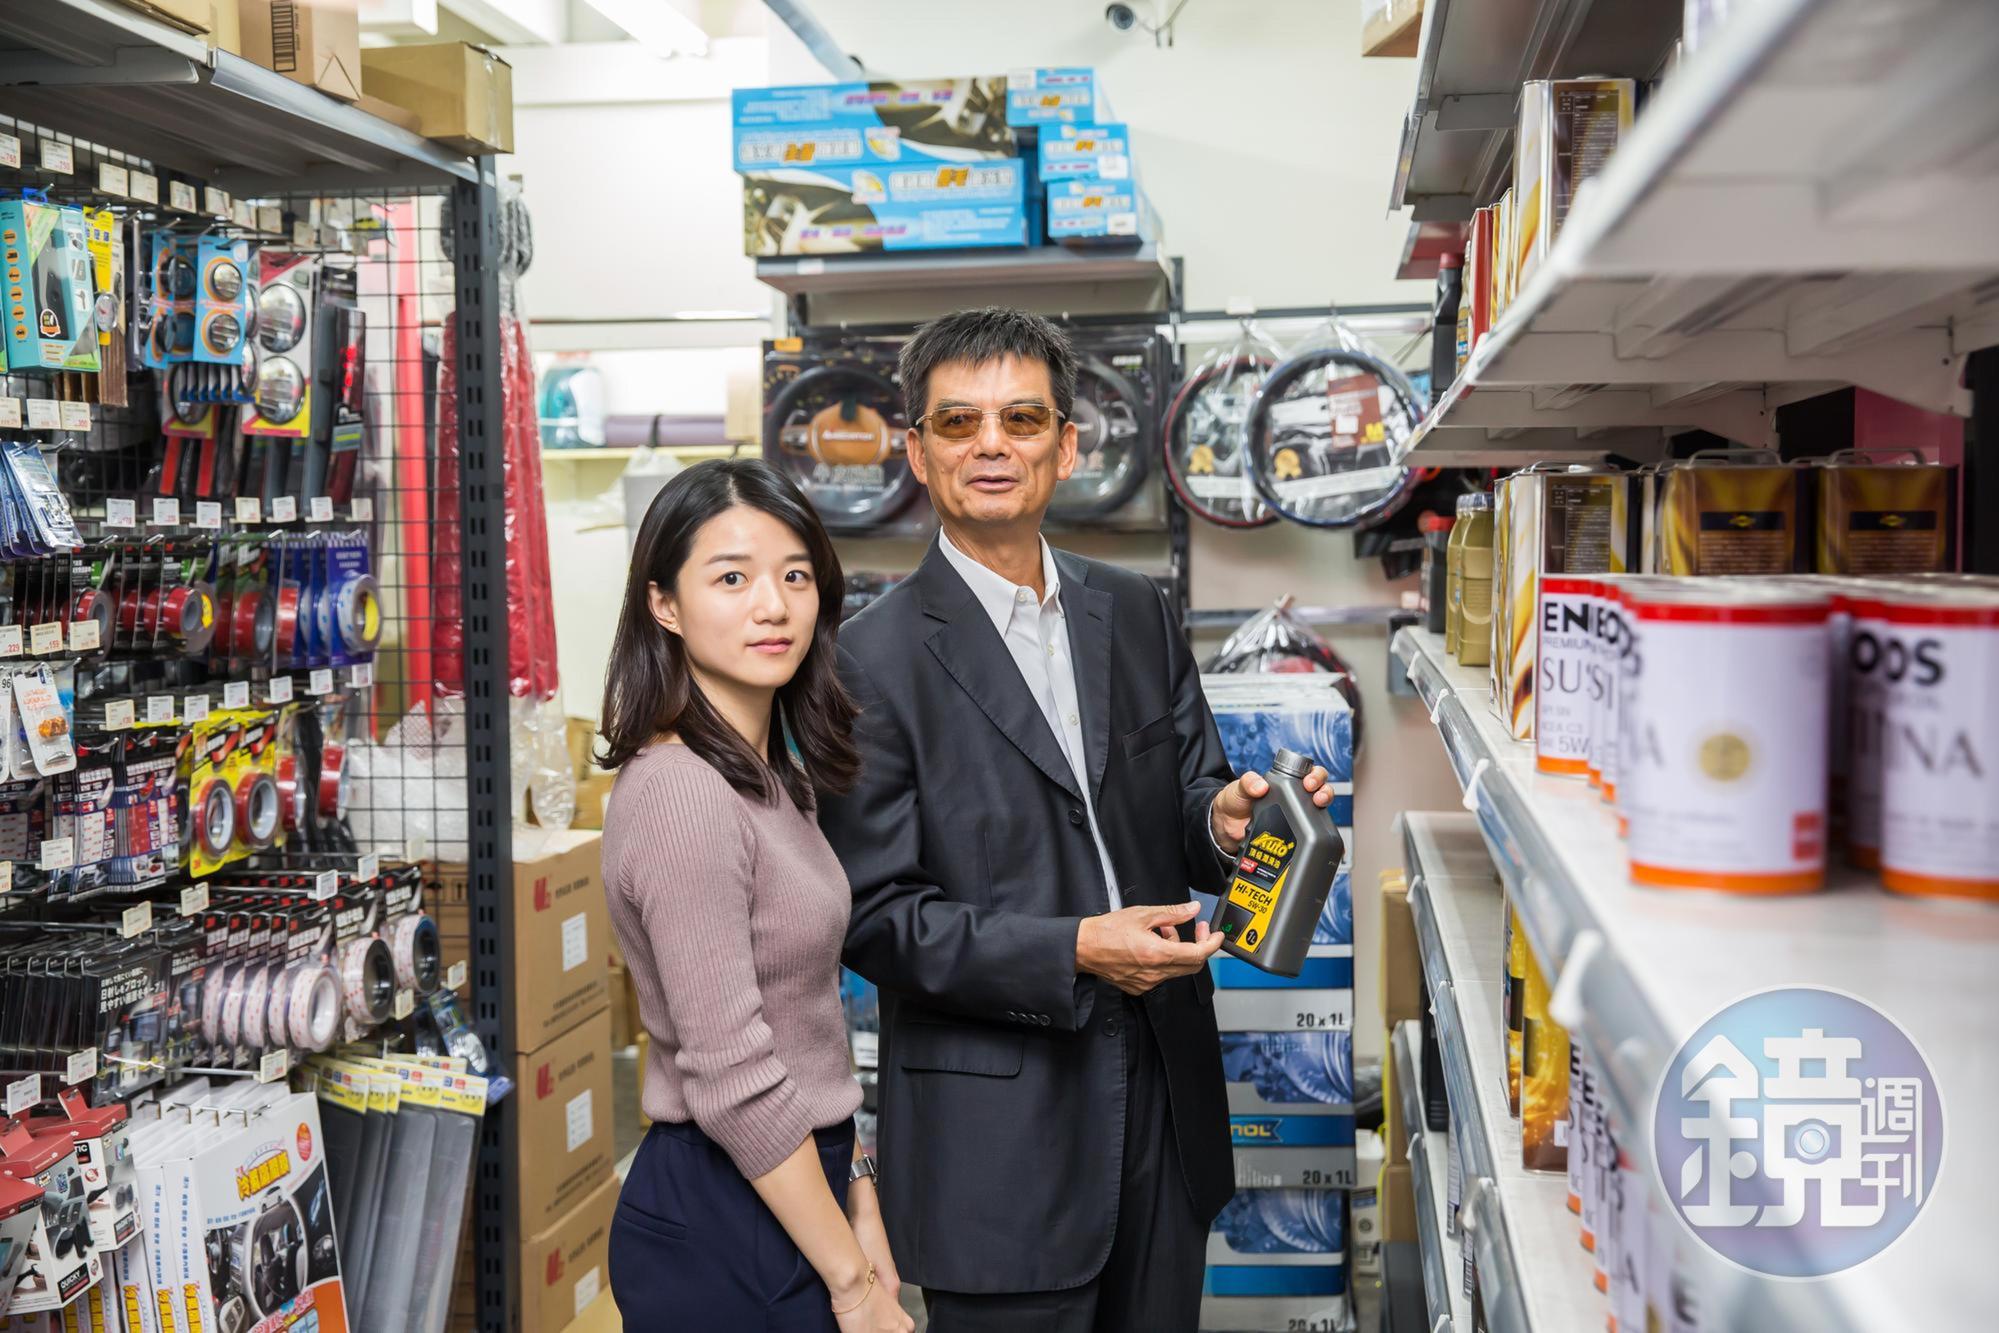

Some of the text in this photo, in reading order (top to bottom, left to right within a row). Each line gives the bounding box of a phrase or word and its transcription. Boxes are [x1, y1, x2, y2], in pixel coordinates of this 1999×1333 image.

[1235, 883, 1272, 905] HI-TECH
[1296, 1013, 1315, 1027] 20
[1329, 1012, 1344, 1026] 1L
[1302, 1170, 1321, 1184] 20
[1336, 1170, 1352, 1184] 1L
